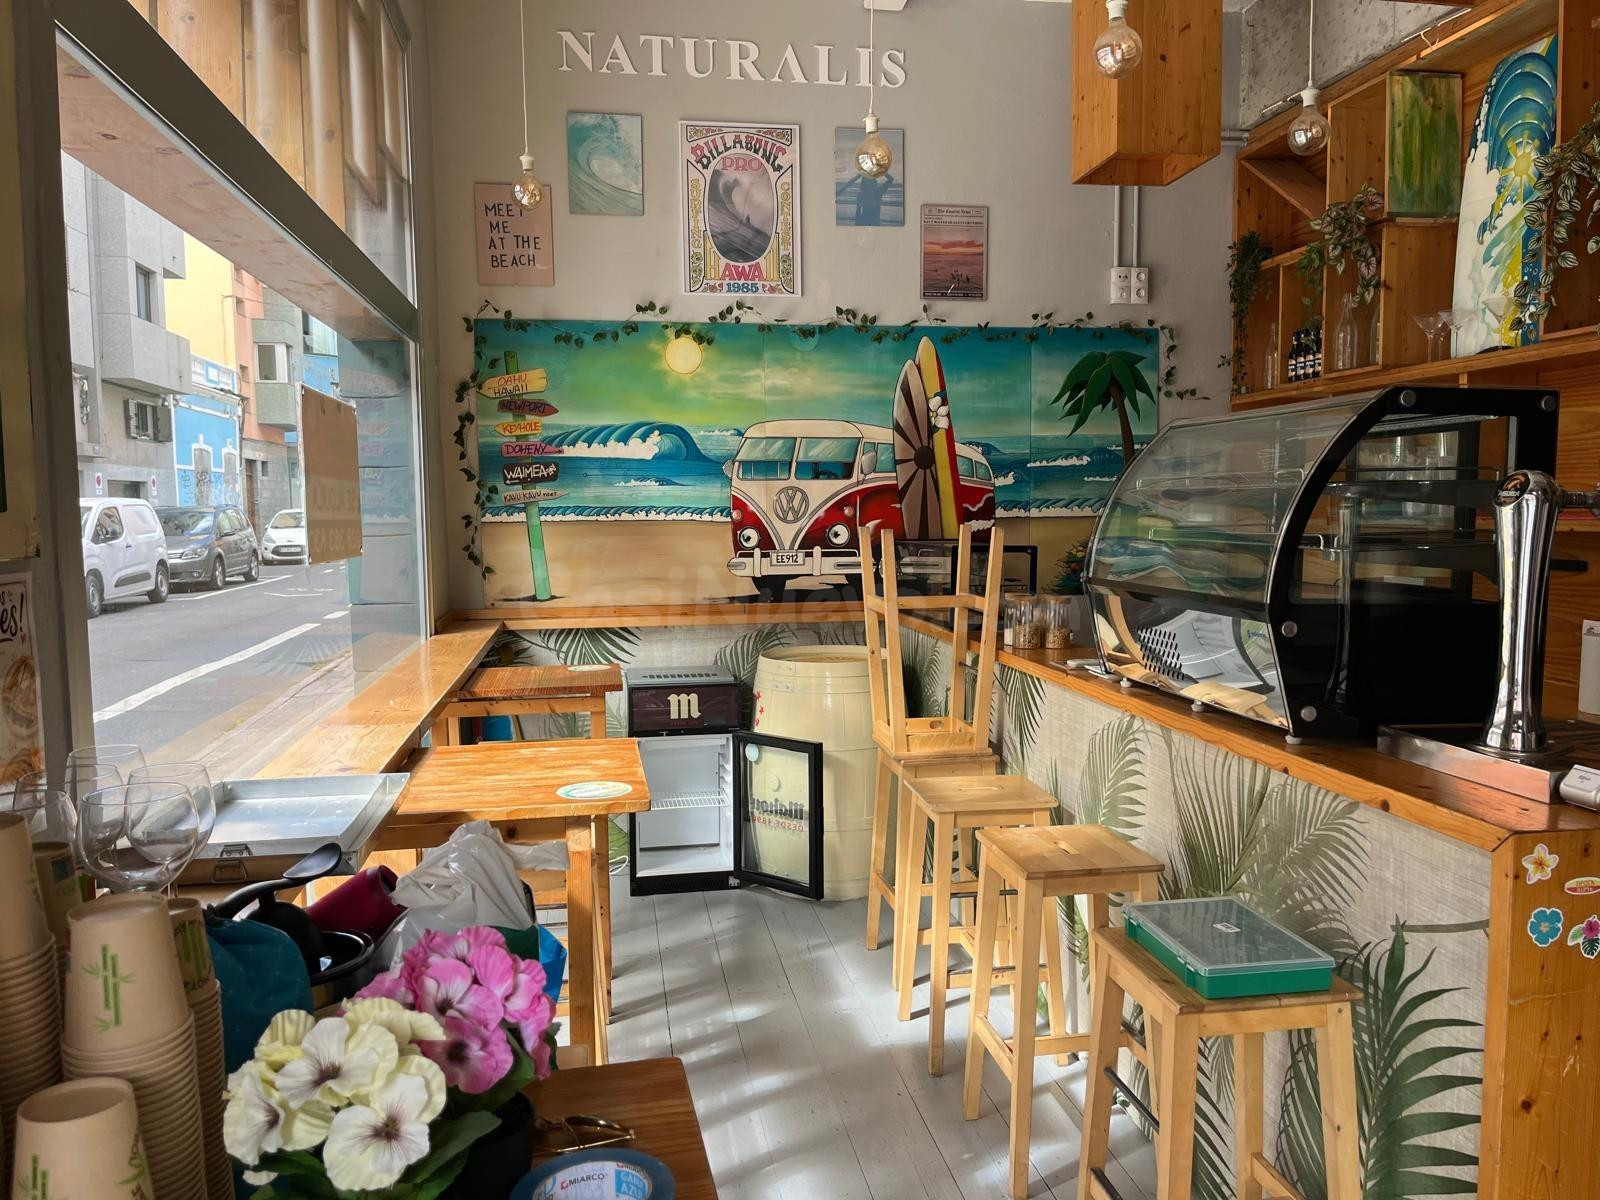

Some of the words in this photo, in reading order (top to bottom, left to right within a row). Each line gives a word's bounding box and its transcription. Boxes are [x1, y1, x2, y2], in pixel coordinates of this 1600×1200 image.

[557, 30, 906, 89] NATURALIS
[690, 134, 787, 173] BILLABONG
[721, 156, 763, 172] PRO
[690, 178, 702, 249] SURFING
[780, 181, 791, 251] CONTEST
[489, 220, 511, 233] ME
[488, 236, 506, 250] AT
[513, 234, 542, 250] THE
[490, 254, 536, 268] BEACH
[704, 231, 780, 281] HAWAII
[726, 282, 760, 294] 1985
[497, 373, 528, 387] OAHU
[493, 383, 528, 397] HAWAII
[500, 400, 547, 414] NEWPORT
[502, 421, 541, 434] KEYHOLE
[504, 444, 547, 455] DOHENY
[503, 463, 548, 480] WAIMEA
[503, 493, 521, 503] KAVU
[523, 491, 542, 501] KAVU
[776, 554, 799, 564] EE912
[568, 1172, 605, 1186] MIARCO
